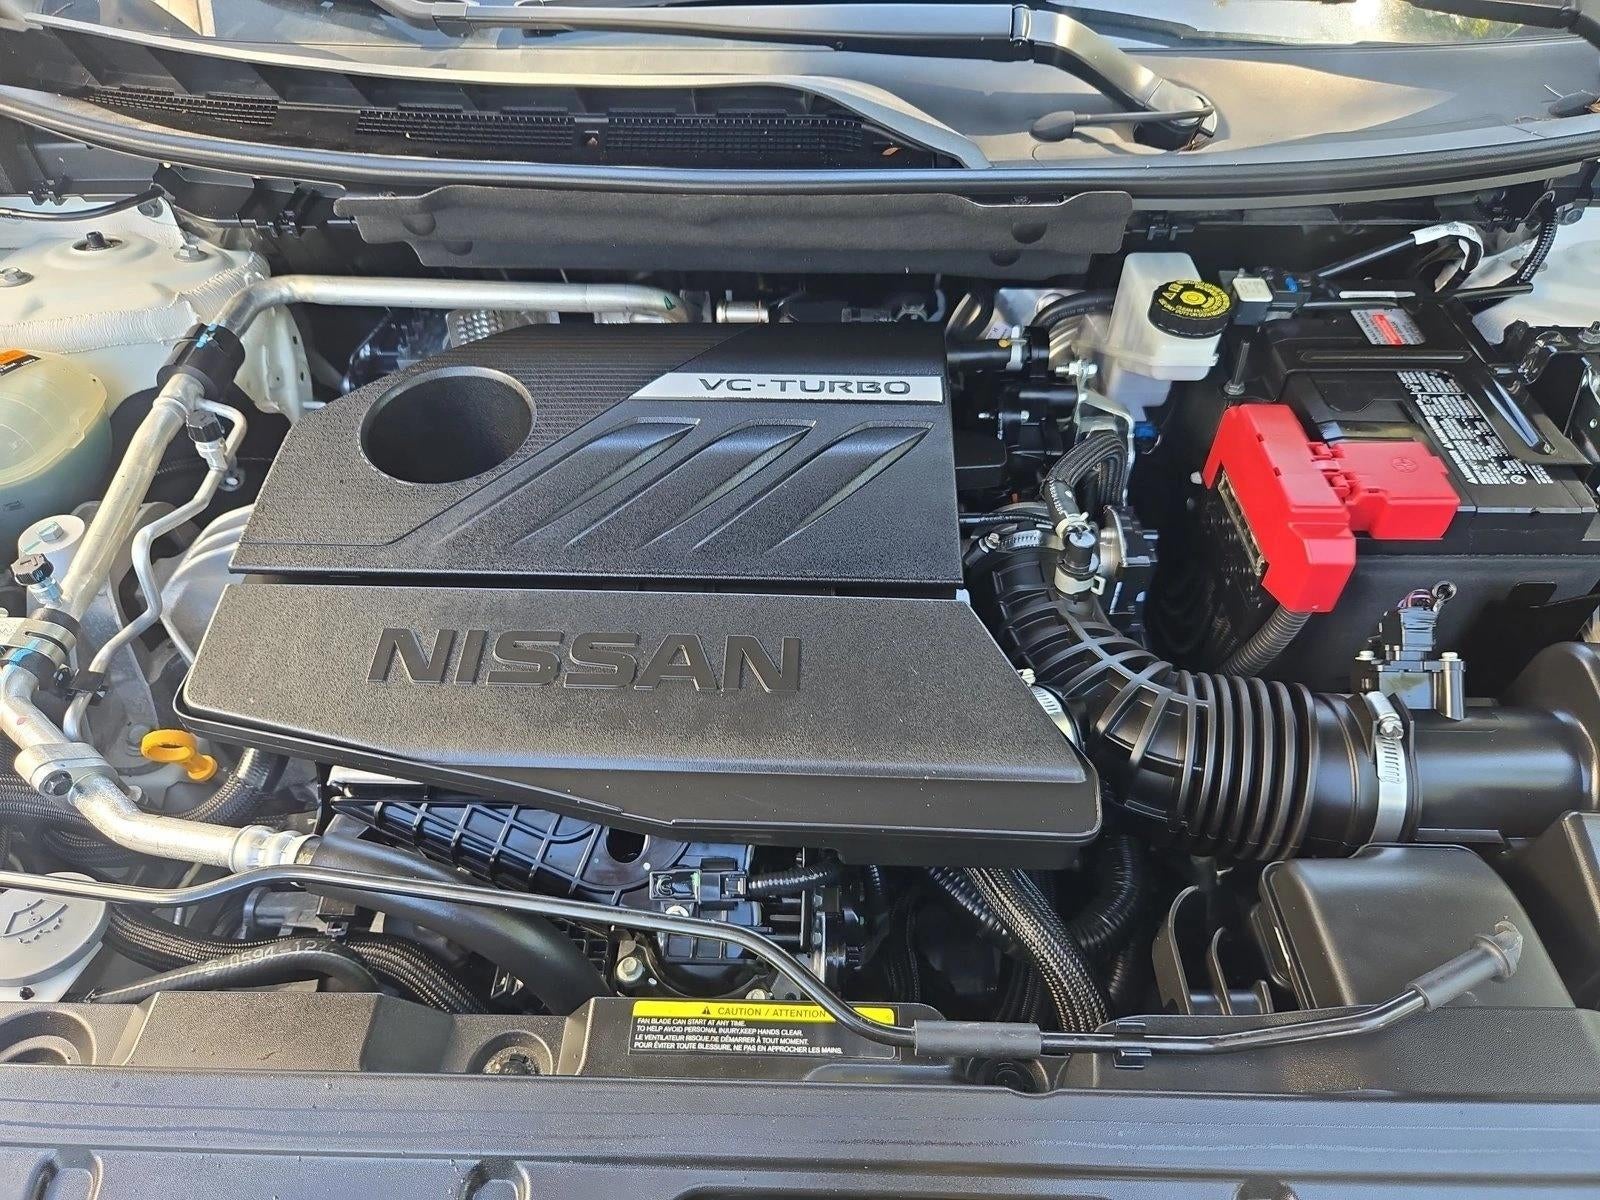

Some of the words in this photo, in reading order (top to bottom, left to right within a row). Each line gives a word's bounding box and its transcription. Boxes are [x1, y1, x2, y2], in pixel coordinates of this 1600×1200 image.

[699, 378, 911, 395] VC-TURBO
[366, 628, 801, 693] NISSAN
[718, 1007, 761, 1016] CAUTION
[764, 1008, 770, 1016] /
[772, 1008, 826, 1018] ATTENTION
[684, 1026, 717, 1034] PERSONAL
[720, 1035, 755, 1043] DÉMARRER
[756, 1035, 762, 1044] À
[654, 1040, 675, 1049] ÉVITER
[698, 1043, 732, 1051] BLESSURE,
